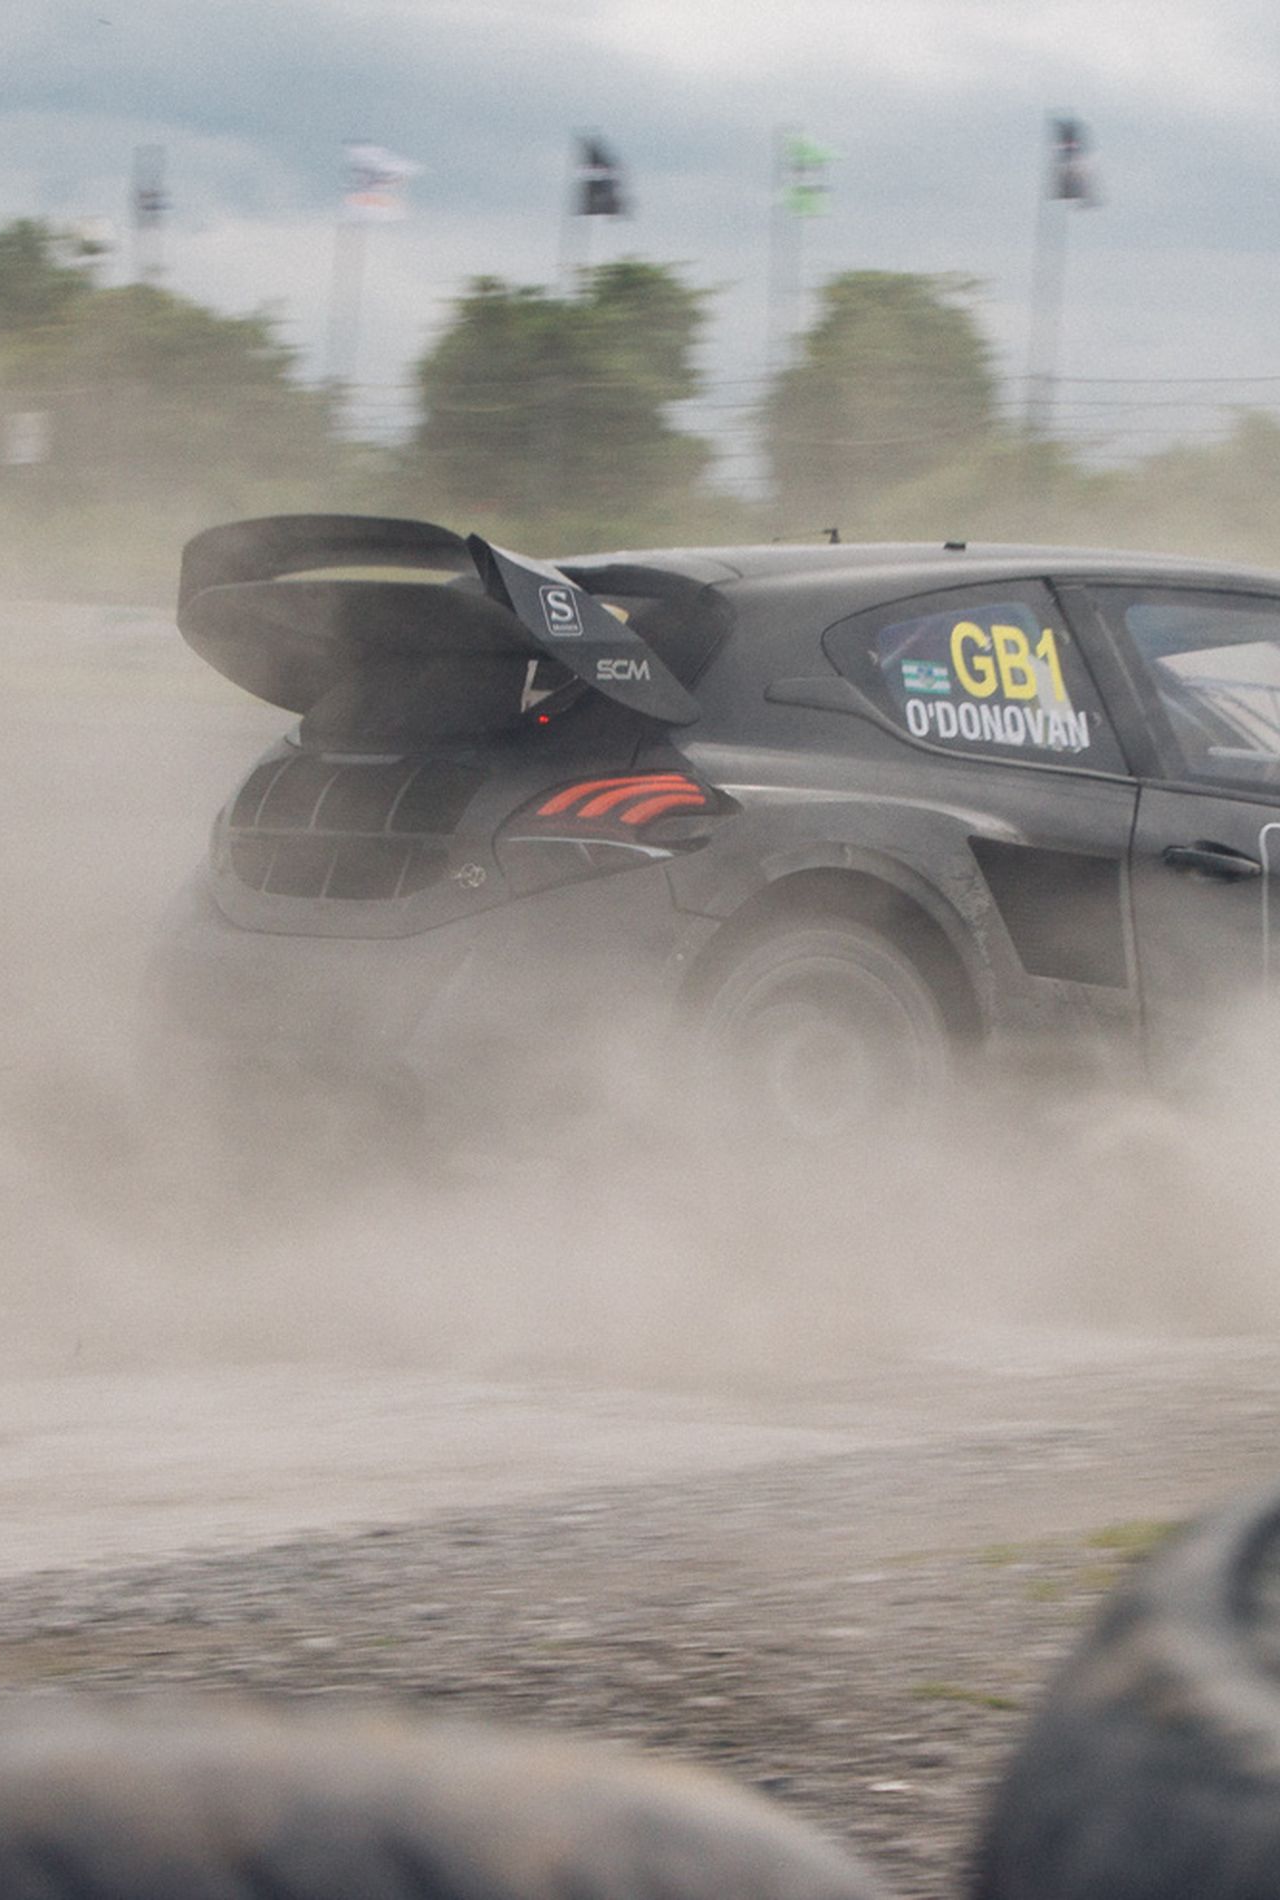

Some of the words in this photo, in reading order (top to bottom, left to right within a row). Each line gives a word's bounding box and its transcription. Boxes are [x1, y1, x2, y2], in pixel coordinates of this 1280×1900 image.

[546, 590, 574, 622] S
[596, 659, 651, 681] SCM
[950, 621, 1066, 703] GB1
[906, 698, 1090, 750] O'DONOVAN
